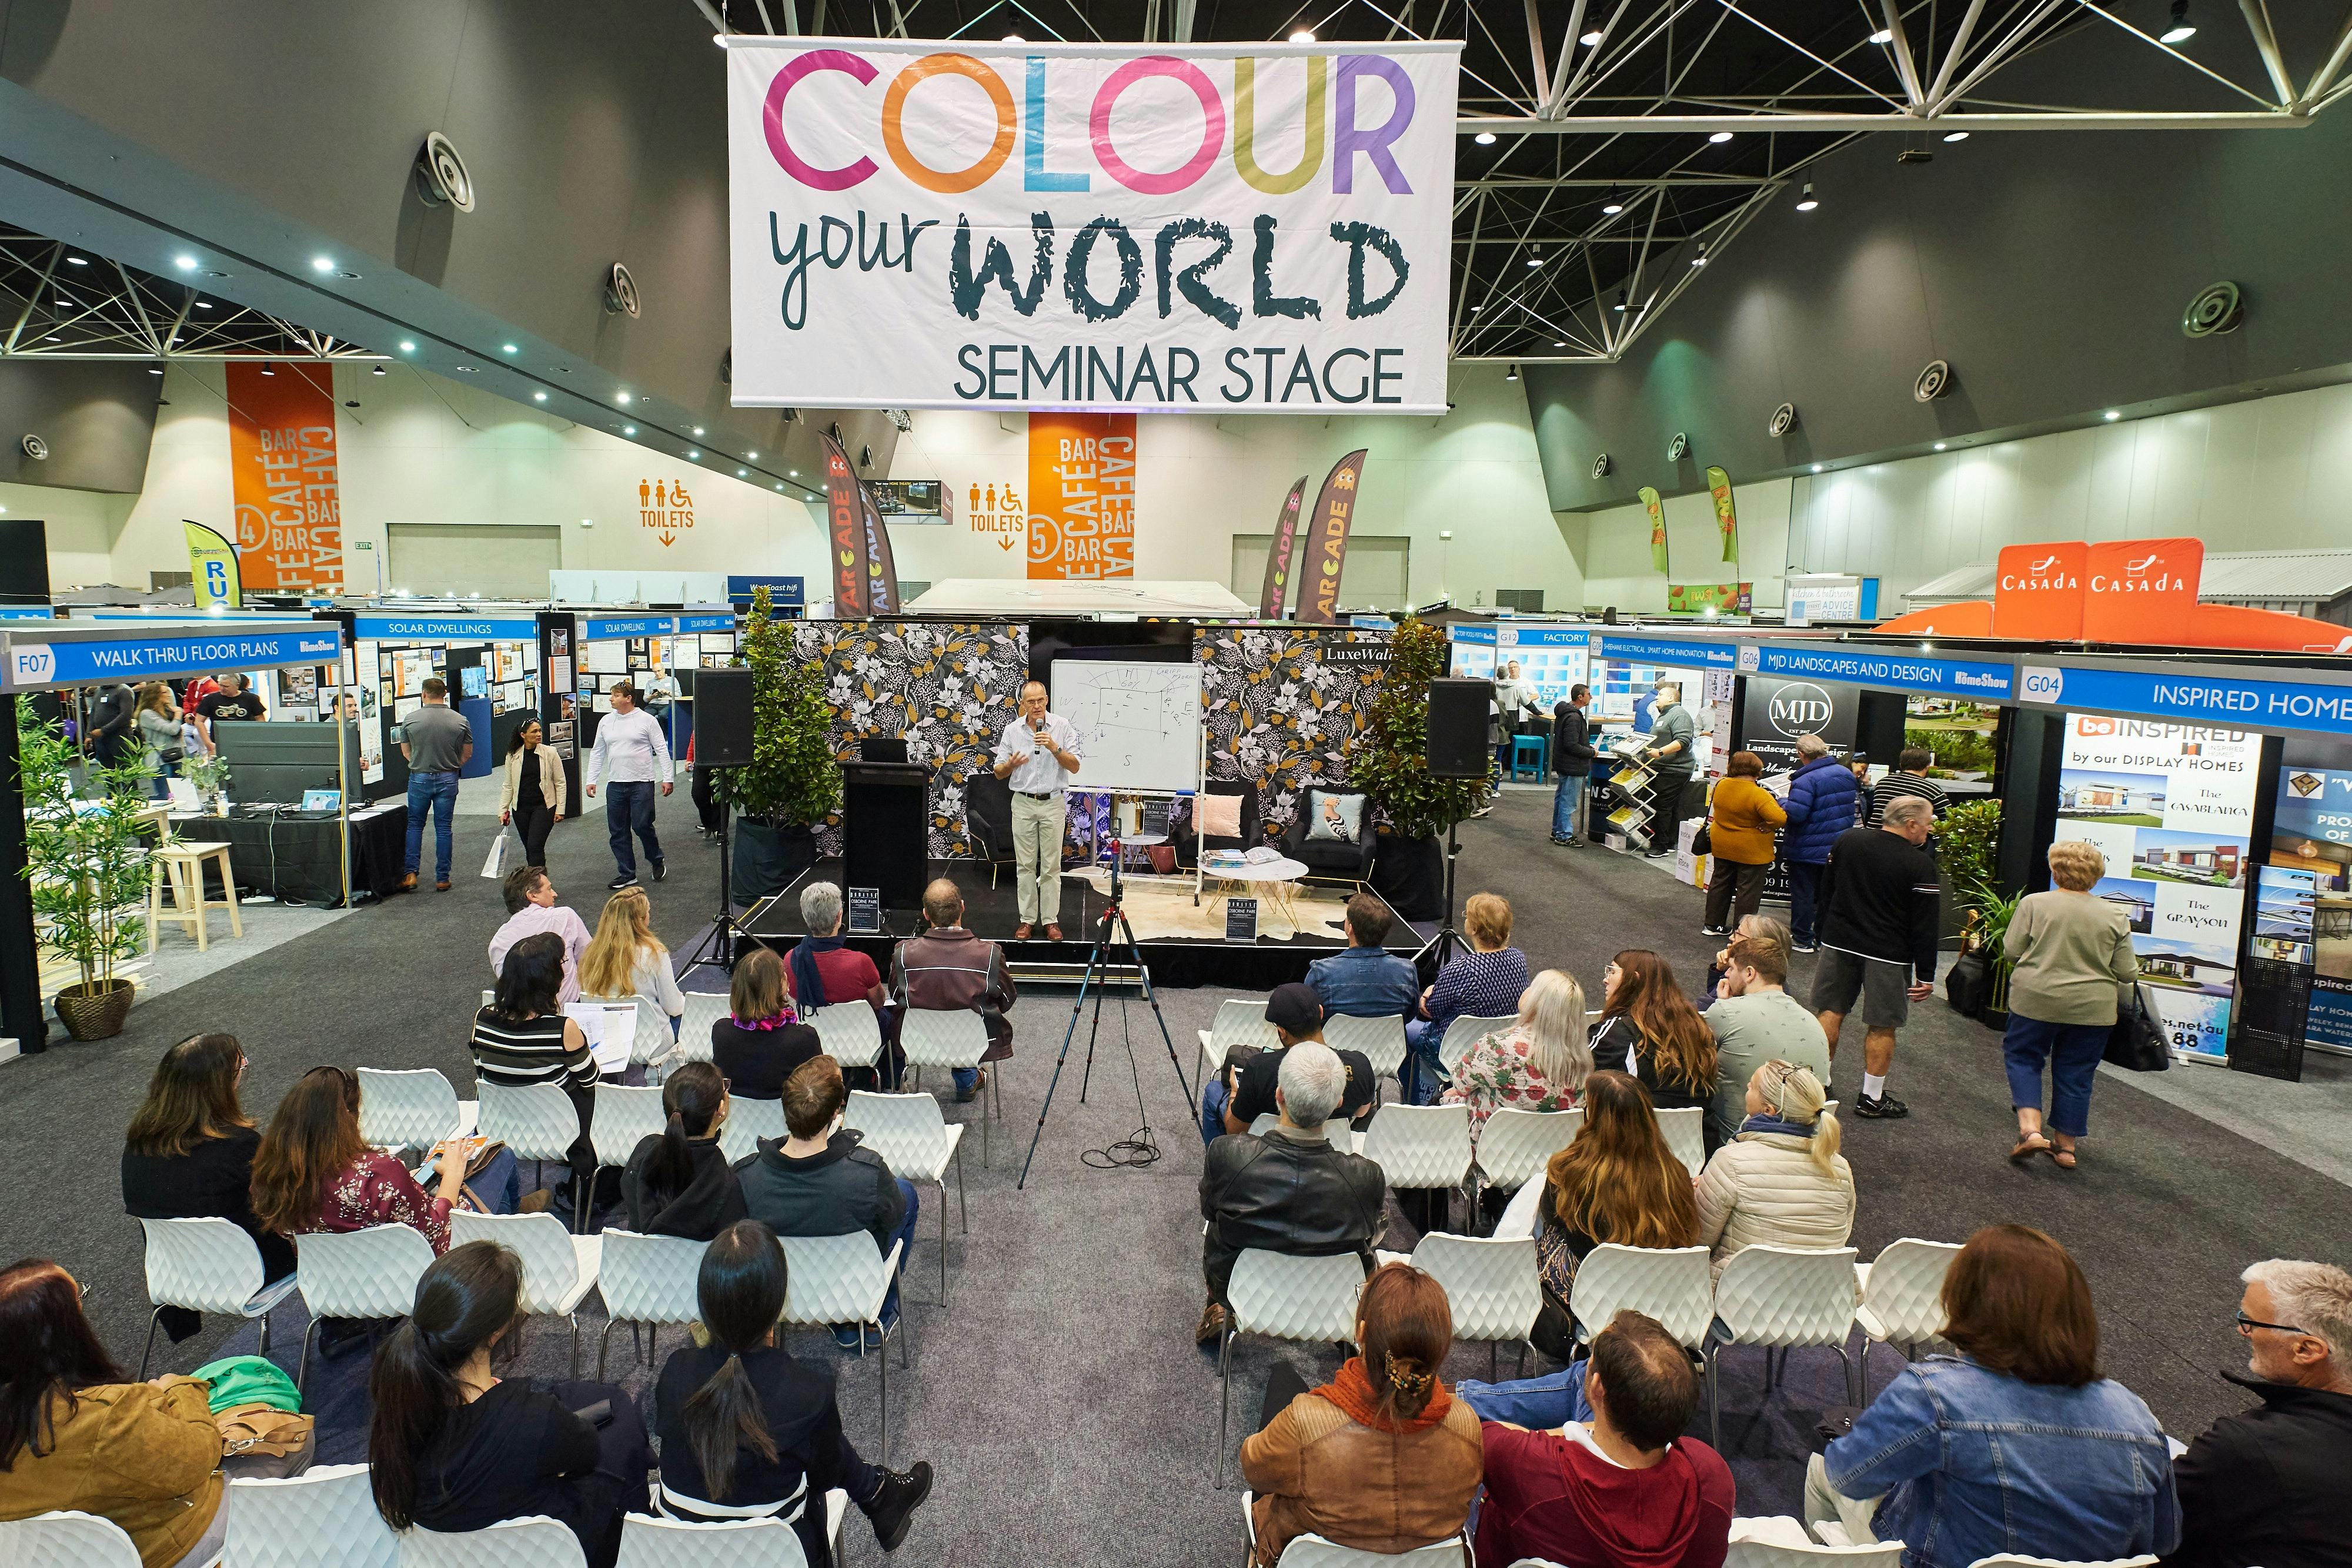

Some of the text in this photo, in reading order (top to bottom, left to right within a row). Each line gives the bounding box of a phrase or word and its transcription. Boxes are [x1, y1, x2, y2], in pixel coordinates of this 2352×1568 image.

[763, 49, 1415, 195] COLOUR
[769, 210, 1409, 330] your WORLD
[955, 342, 1403, 404] SEMINAR STAGE
[260, 428, 298, 452] BAR
[1060, 438, 1097, 462] BAR
[255, 454, 305, 526] CAFÉ
[1053, 464, 1098, 537] CAFÉ
[306, 500, 340, 523] BAR
[640, 510, 694, 528] TOILETS
[1101, 510, 1135, 534] BAR
[240, 513, 255, 543] 4
[970, 514, 1023, 532] TOILETS
[272, 528, 309, 551] BAR
[834, 489, 858, 609] ARCADE
[1032, 523, 1045, 554] 5
[1064, 539, 1101, 561] BAR
[1317, 500, 1348, 618] ARCADE
[1269, 520, 1294, 620] ARCADE
[1821, 611, 1853, 620] CENTRE
[1822, 601, 1854, 610] ADVICE
[389, 623, 492, 634] SOLAR DWELLINGS
[605, 622, 646, 633] SOLAR DWELLINGS
[700, 618, 716, 627] DWELLINGS
[1544, 634, 1585, 642] FACTORY
[92, 641, 279, 667] WALK THRU FLOOR PLANS
[1622, 644, 1645, 653] ELECTRICAL
[1647, 646, 1661, 654] SMART
[1662, 647, 1675, 656] HOME
[1676, 648, 1706, 658] INNOVATION
[1742, 652, 1758, 665] G06
[19, 654, 49, 673] F07
[1768, 654, 1942, 683] MJD LANDSCAPES AND DESIGN
[2027, 676, 2059, 693] G04
[1773, 698, 1829, 724] MJD
[2153, 684, 2352, 721] INSPIRED HOME
[2082, 718, 2112, 734] be
[1123, 754, 1132, 766] S
[1746, 743, 1799, 756] Landscape
[2073, 752, 2243, 772] by our DISPLAY HOMES
[2199, 788, 2222, 799] The
[2317, 814, 2352, 828] PRO
[2325, 830, 2350, 841] OF
[2187, 900, 2210, 910] The
